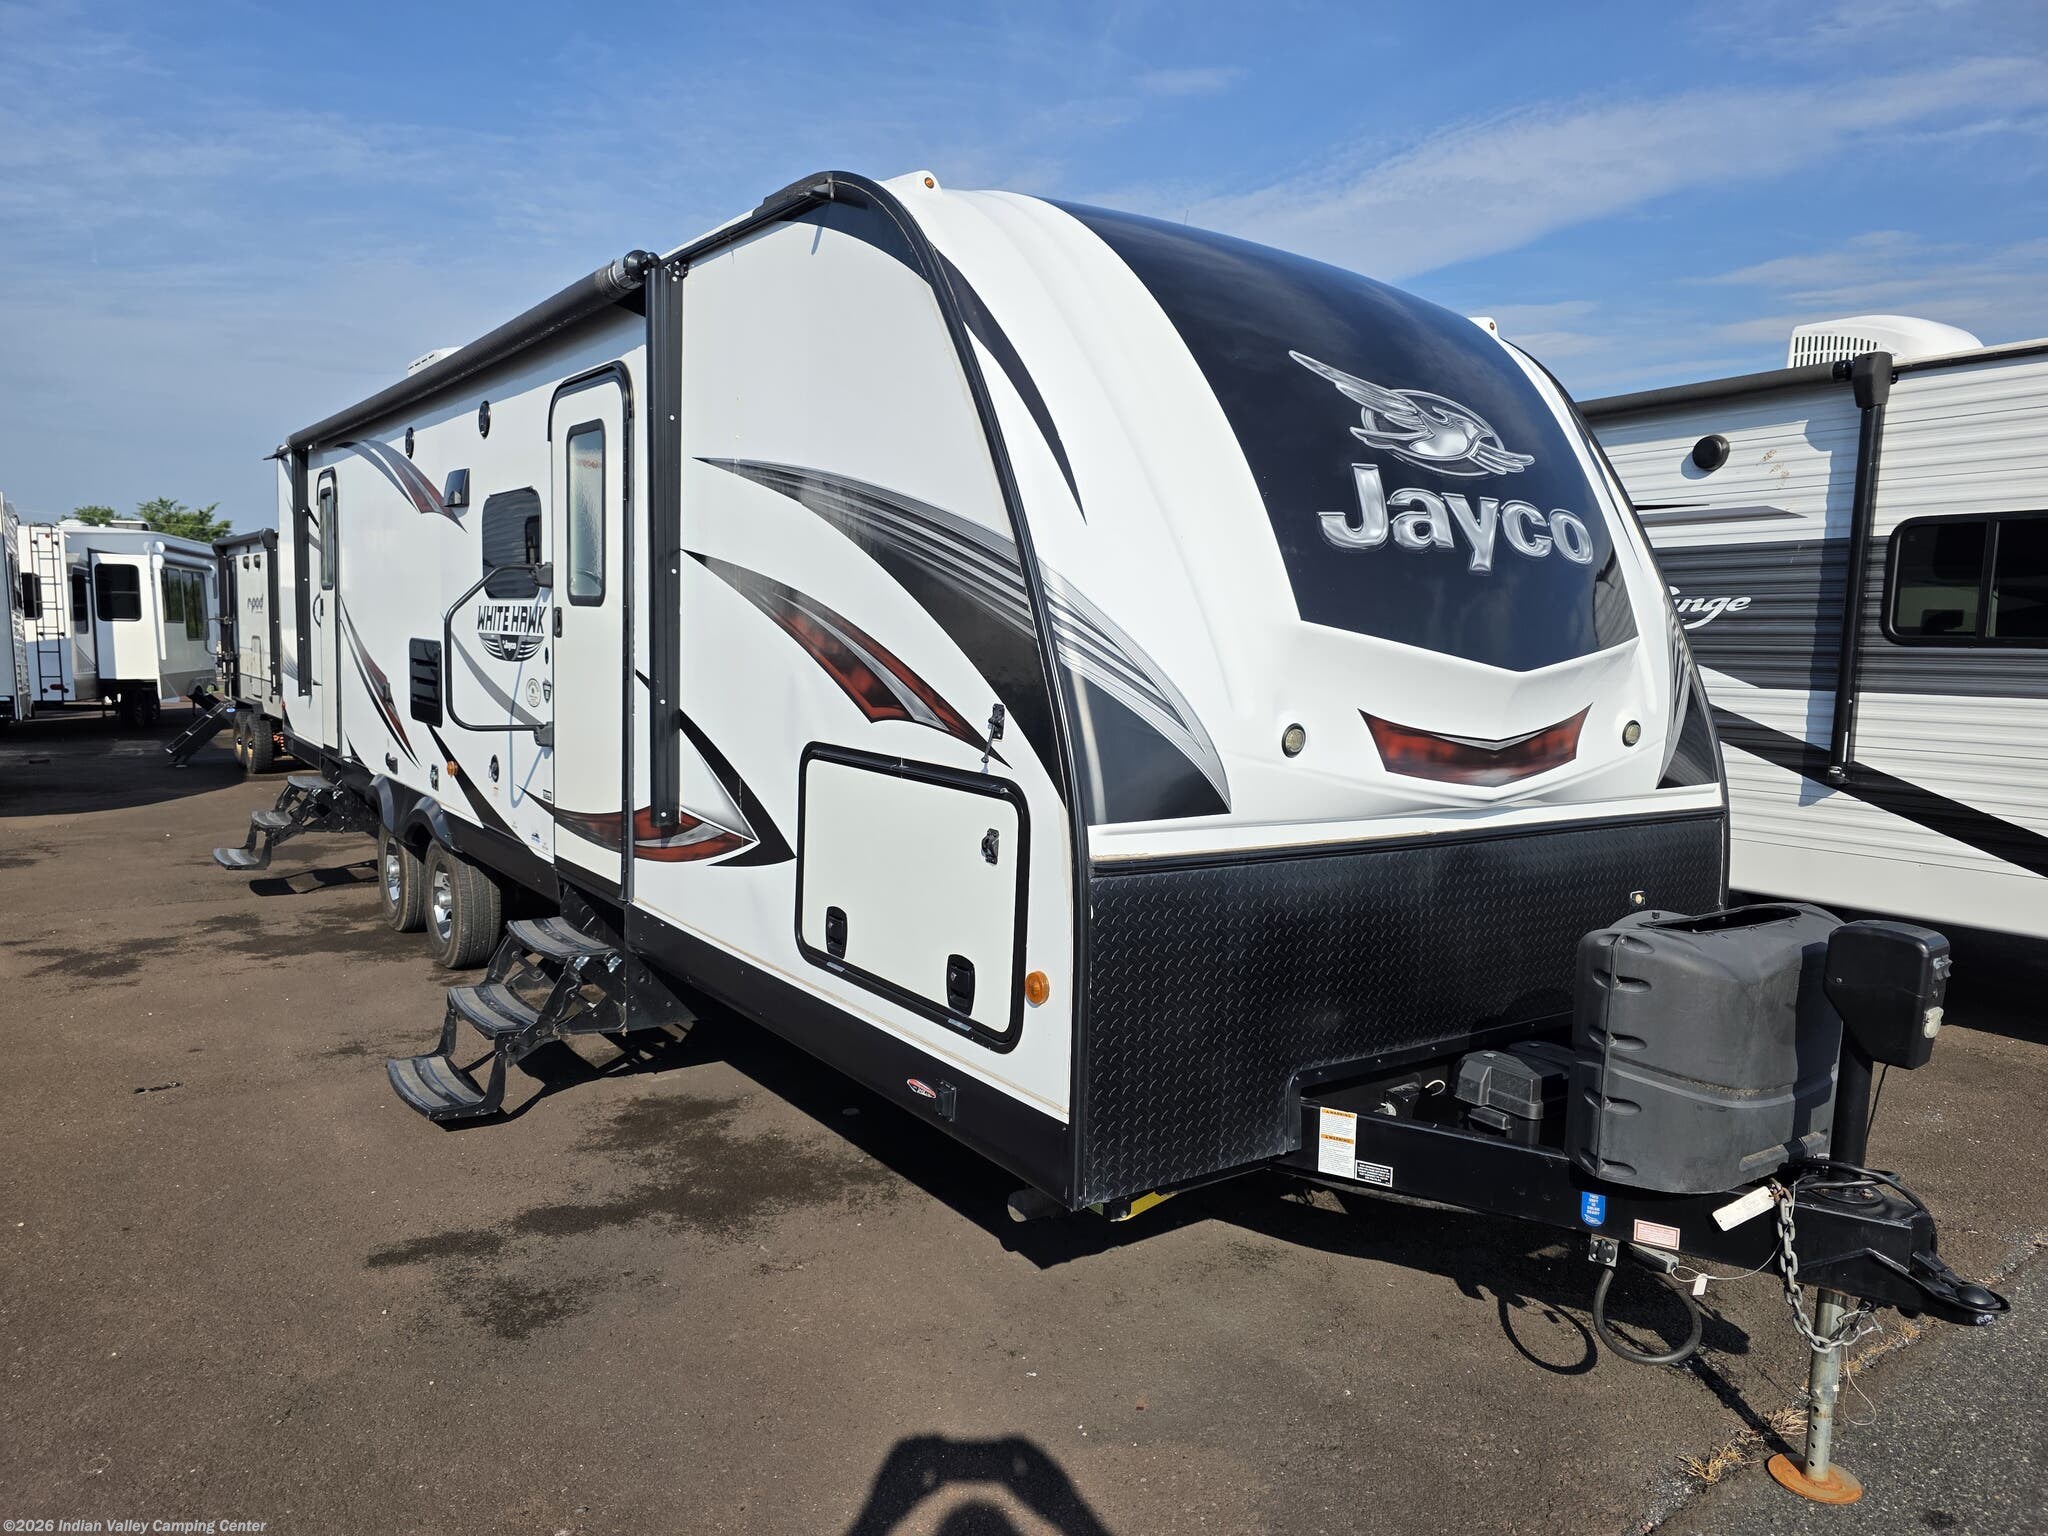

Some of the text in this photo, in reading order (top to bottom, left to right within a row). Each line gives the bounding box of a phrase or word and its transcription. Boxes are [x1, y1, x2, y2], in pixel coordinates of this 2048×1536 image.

[1316, 463, 1593, 574] Jayco
[477, 606, 547, 634] WHITE HAWK
[1669, 586, 1752, 630] nge
